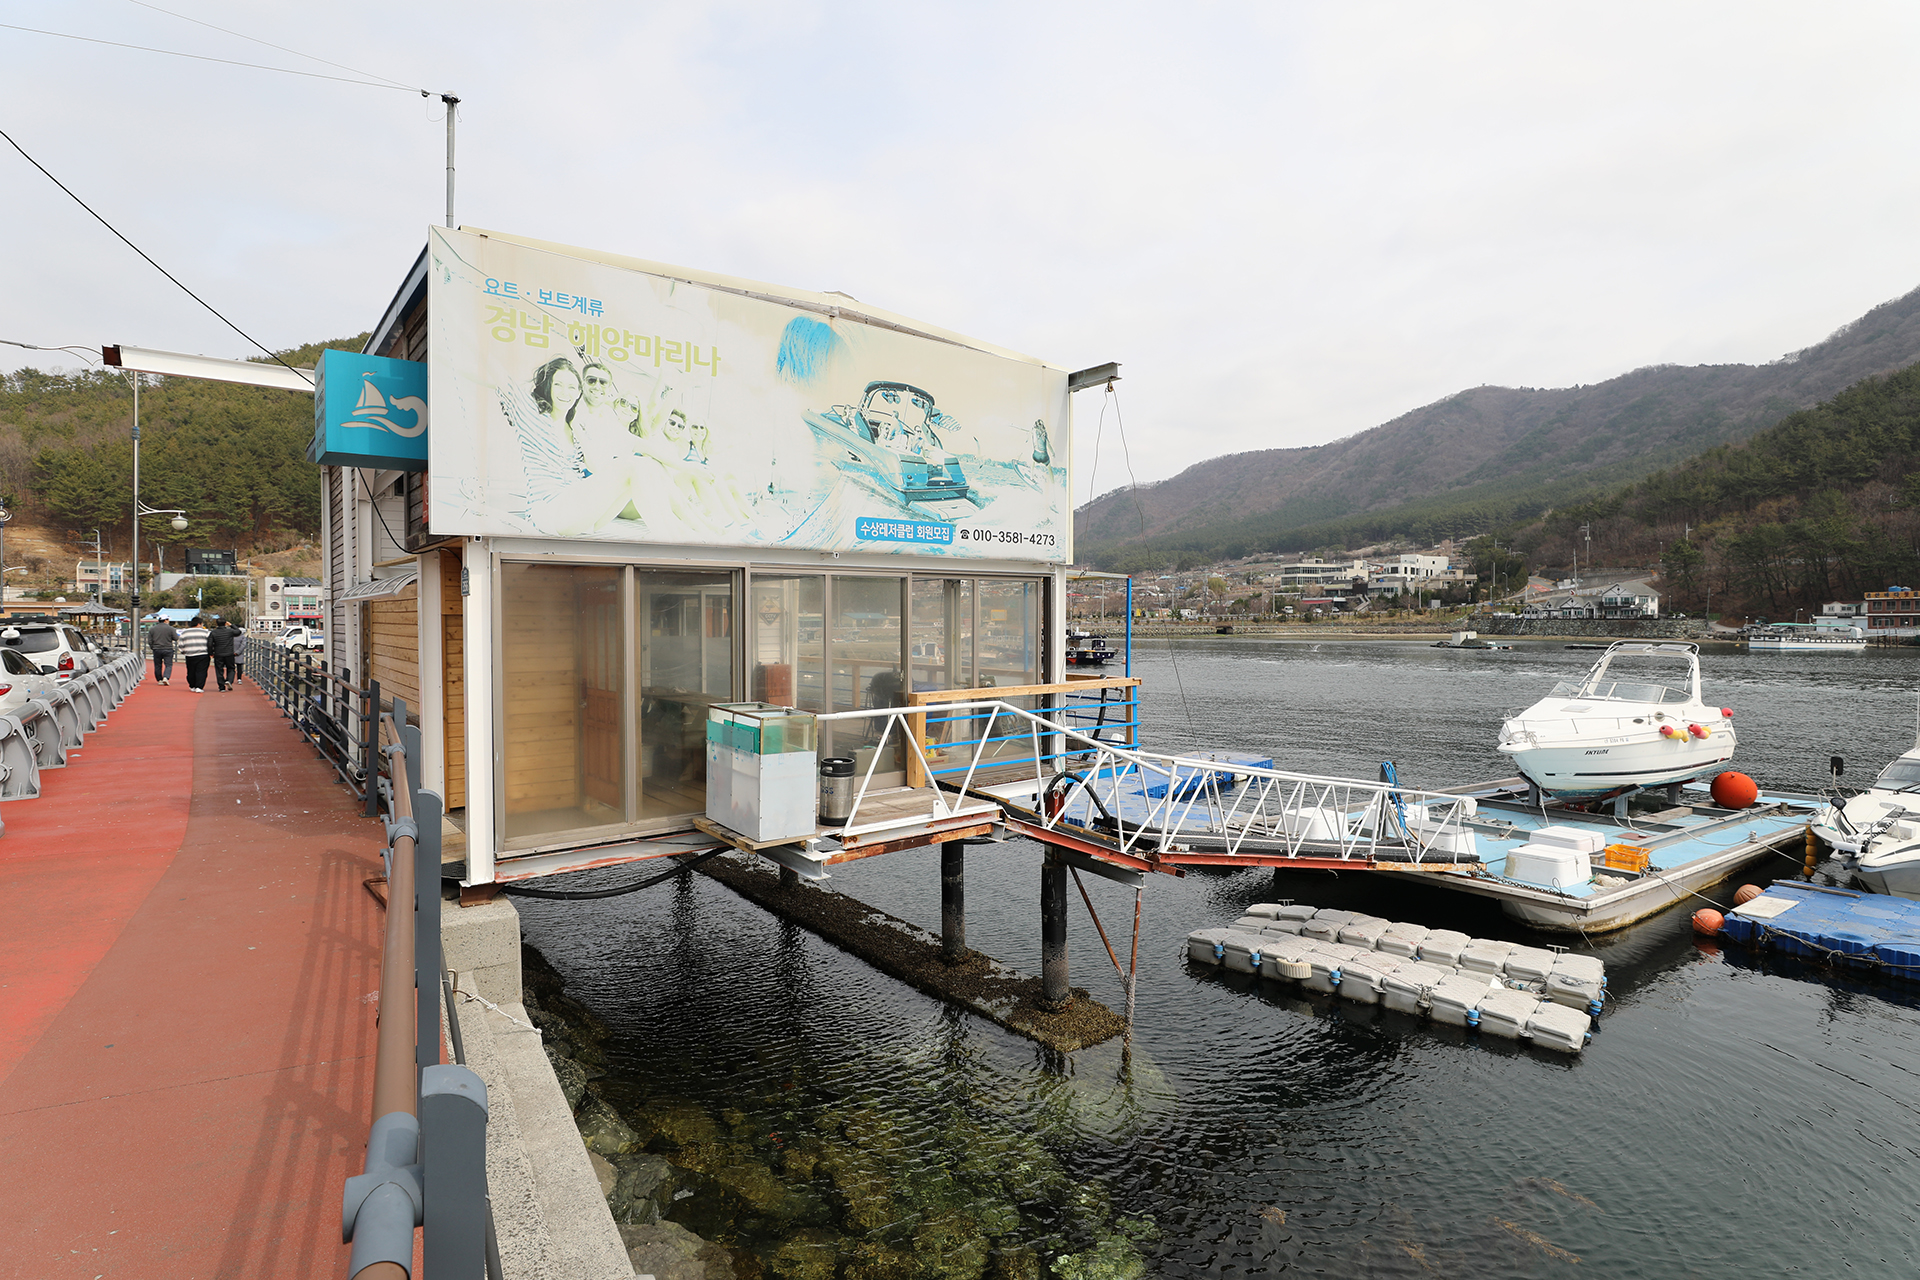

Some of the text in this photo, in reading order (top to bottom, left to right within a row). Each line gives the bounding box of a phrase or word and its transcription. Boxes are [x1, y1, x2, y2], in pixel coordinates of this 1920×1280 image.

[482, 277, 605, 318] 요트 보트계류
[483, 304, 722, 377] 경남 해양마리나
[860, 522, 950, 541] 수상레저클럽 회원모집
[973, 528, 1056, 546] 010-3581-4273
